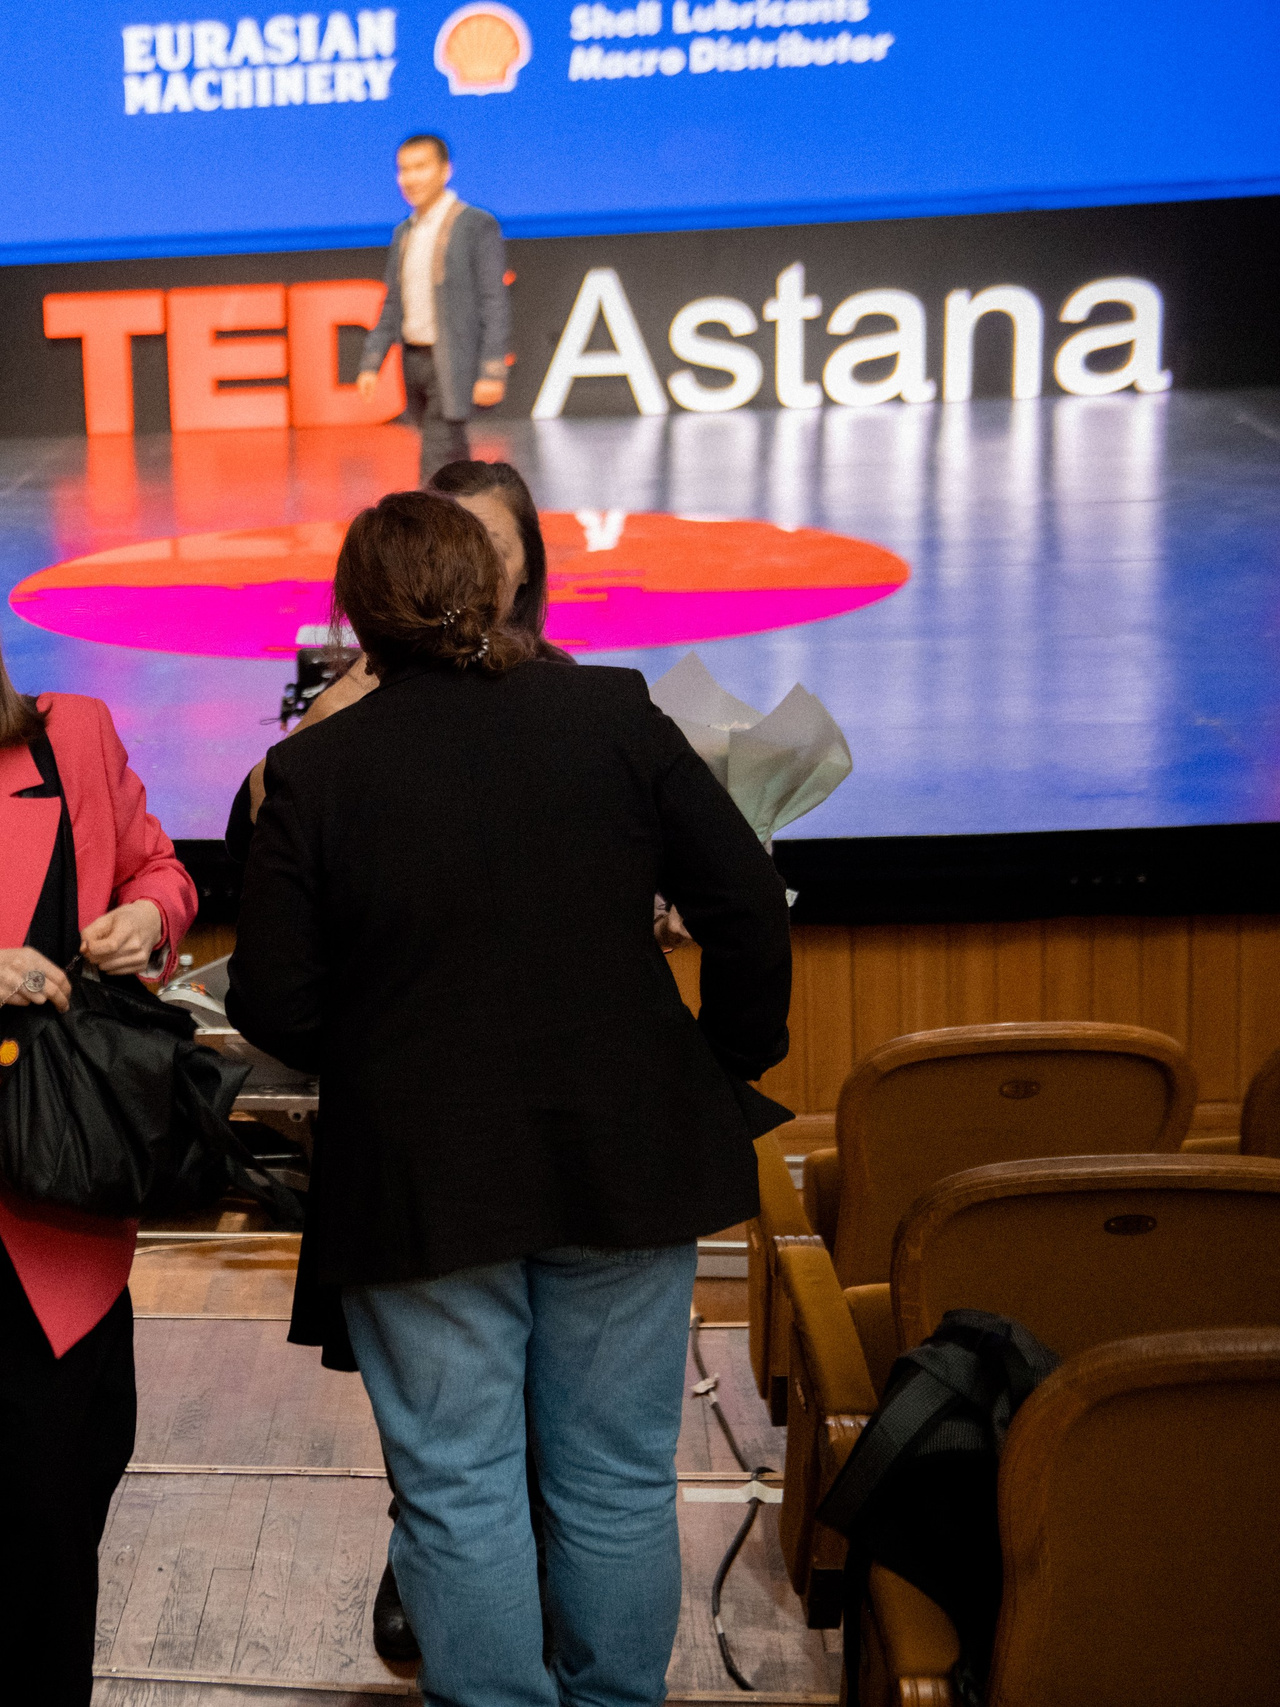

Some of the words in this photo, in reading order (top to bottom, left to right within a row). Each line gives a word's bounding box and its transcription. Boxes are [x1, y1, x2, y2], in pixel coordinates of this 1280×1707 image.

[121, 7, 397, 73] EURASIAN
[570, 0, 663, 41] Shell
[568, 44, 687, 82] Macro
[688, 30, 896, 75] Distributor
[123, 58, 397, 115] MACHINERY
[42, 270, 517, 435] TED
[530, 261, 1174, 419] Astana
